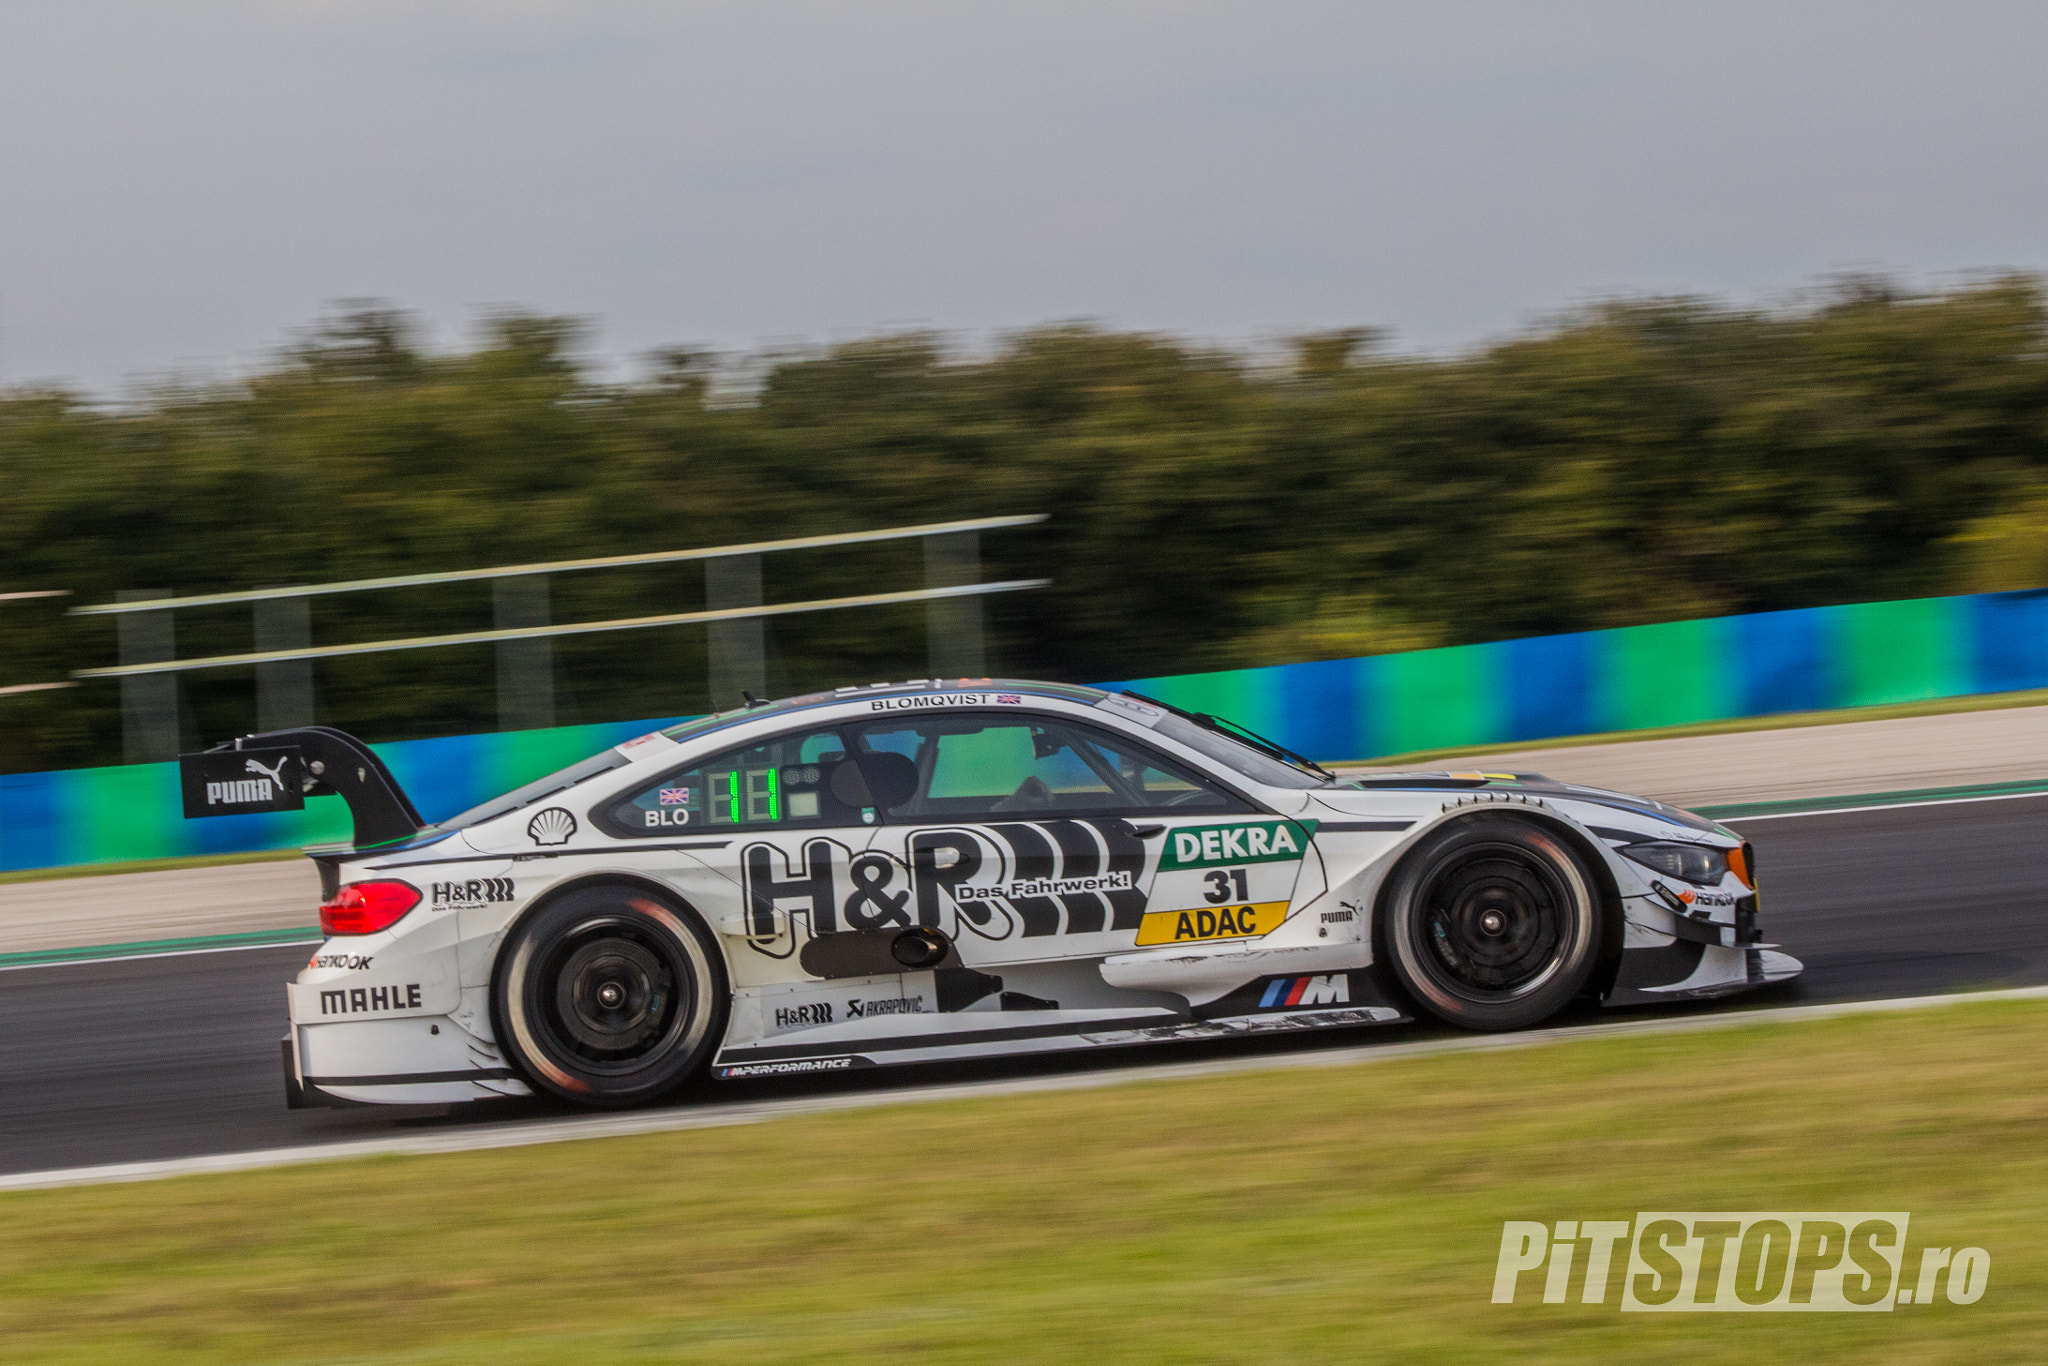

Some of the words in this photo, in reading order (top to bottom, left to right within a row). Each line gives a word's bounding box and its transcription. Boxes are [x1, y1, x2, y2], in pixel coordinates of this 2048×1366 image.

[871, 693, 990, 711] BLOMQVIST
[206, 779, 273, 805] PUMA
[729, 768, 778, 823] 11
[645, 808, 689, 827] BLO
[1174, 824, 1298, 863] DEKRA
[432, 879, 483, 904] H&R
[742, 827, 1010, 959] H&R
[959, 886, 1003, 900] Das
[1011, 874, 1128, 896] Fahrwerk!
[1203, 869, 1249, 904] 31
[1175, 906, 1256, 940] ADAC
[1320, 911, 1353, 924] PUMA
[321, 984, 422, 1014] MAHLE
[776, 1004, 811, 1028] H&R
